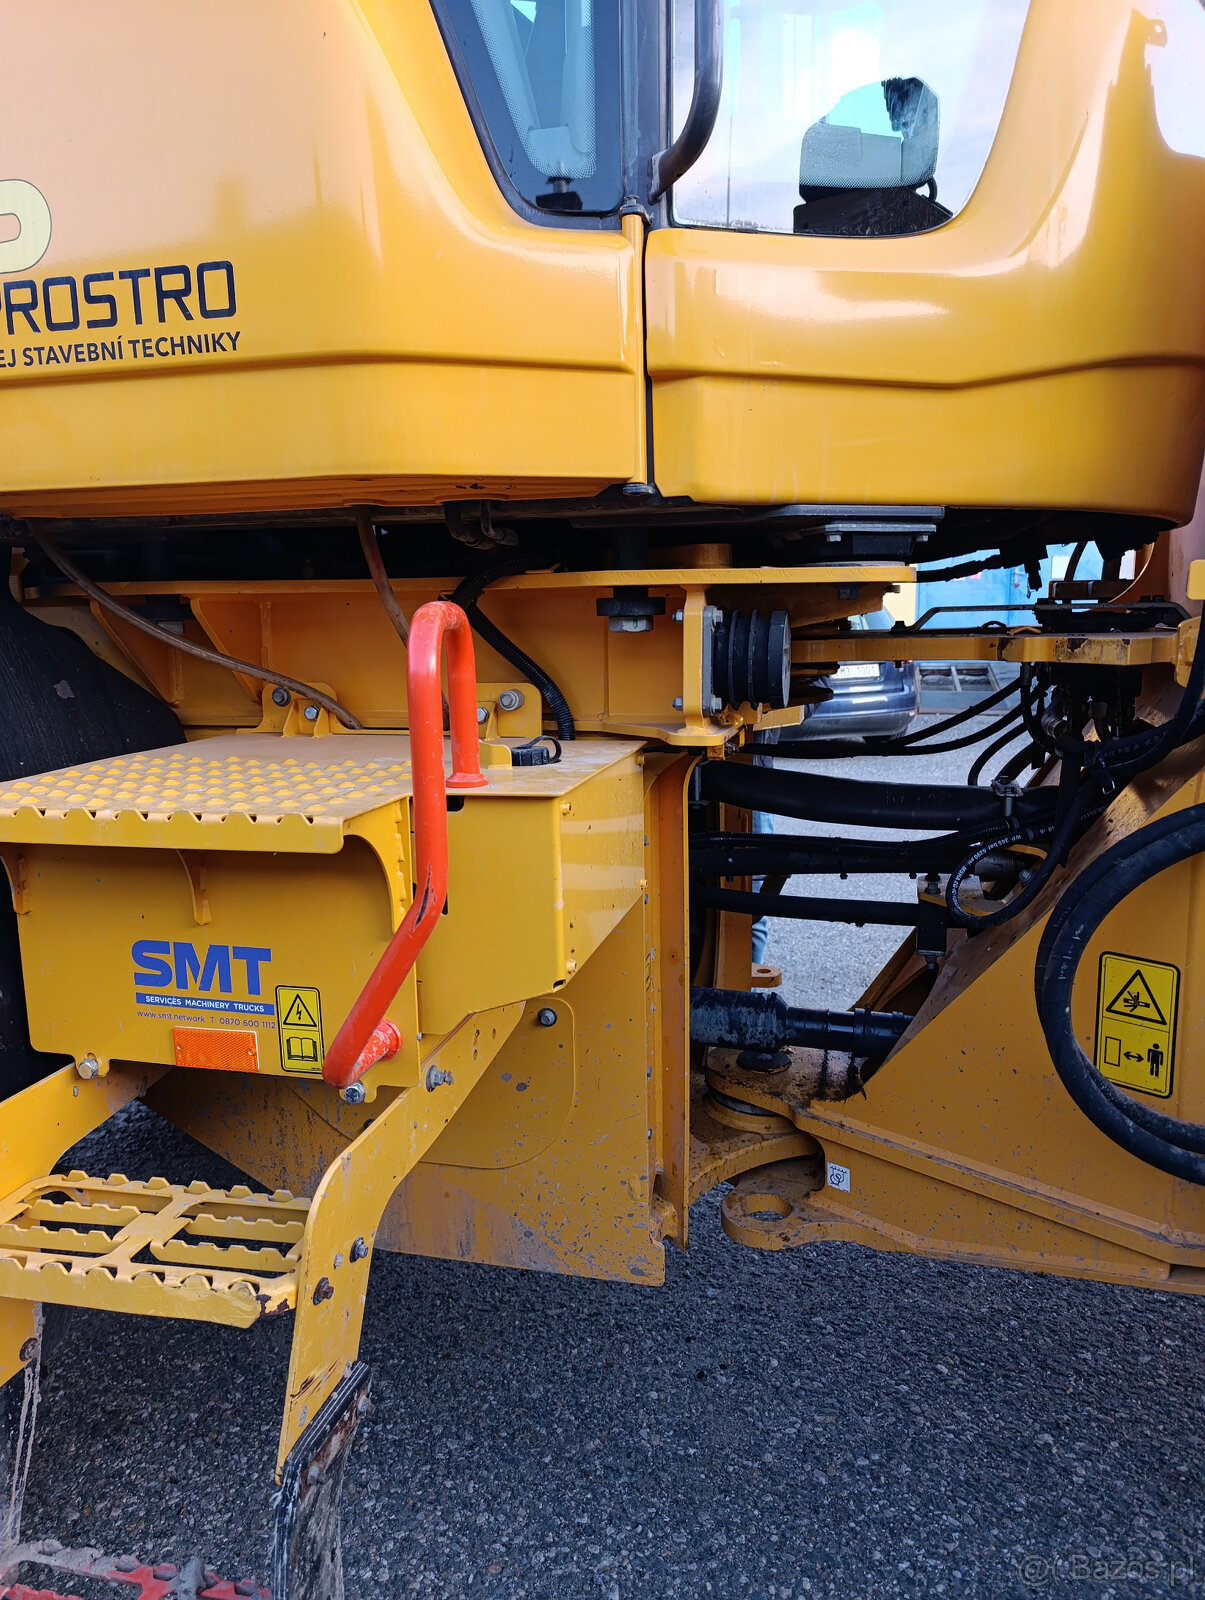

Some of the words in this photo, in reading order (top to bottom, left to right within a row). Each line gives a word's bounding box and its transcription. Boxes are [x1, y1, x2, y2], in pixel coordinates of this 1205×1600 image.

[0, 260, 237, 335] ROSTRO
[22, 335, 124, 367] STAVEBNÍ
[128, 331, 241, 358] TECHNIKY
[131, 939, 272, 996] SMT
[137, 1011, 206, 1023] www.smt.network
[219, 1017, 241, 1026] 0870
[242, 1019, 260, 1027] 600
[262, 1021, 276, 1029] 1112
[145, 995, 182, 1006] SERVICES
[185, 999, 230, 1009] MACHINERY
[234, 1003, 265, 1013] TRUCKS
